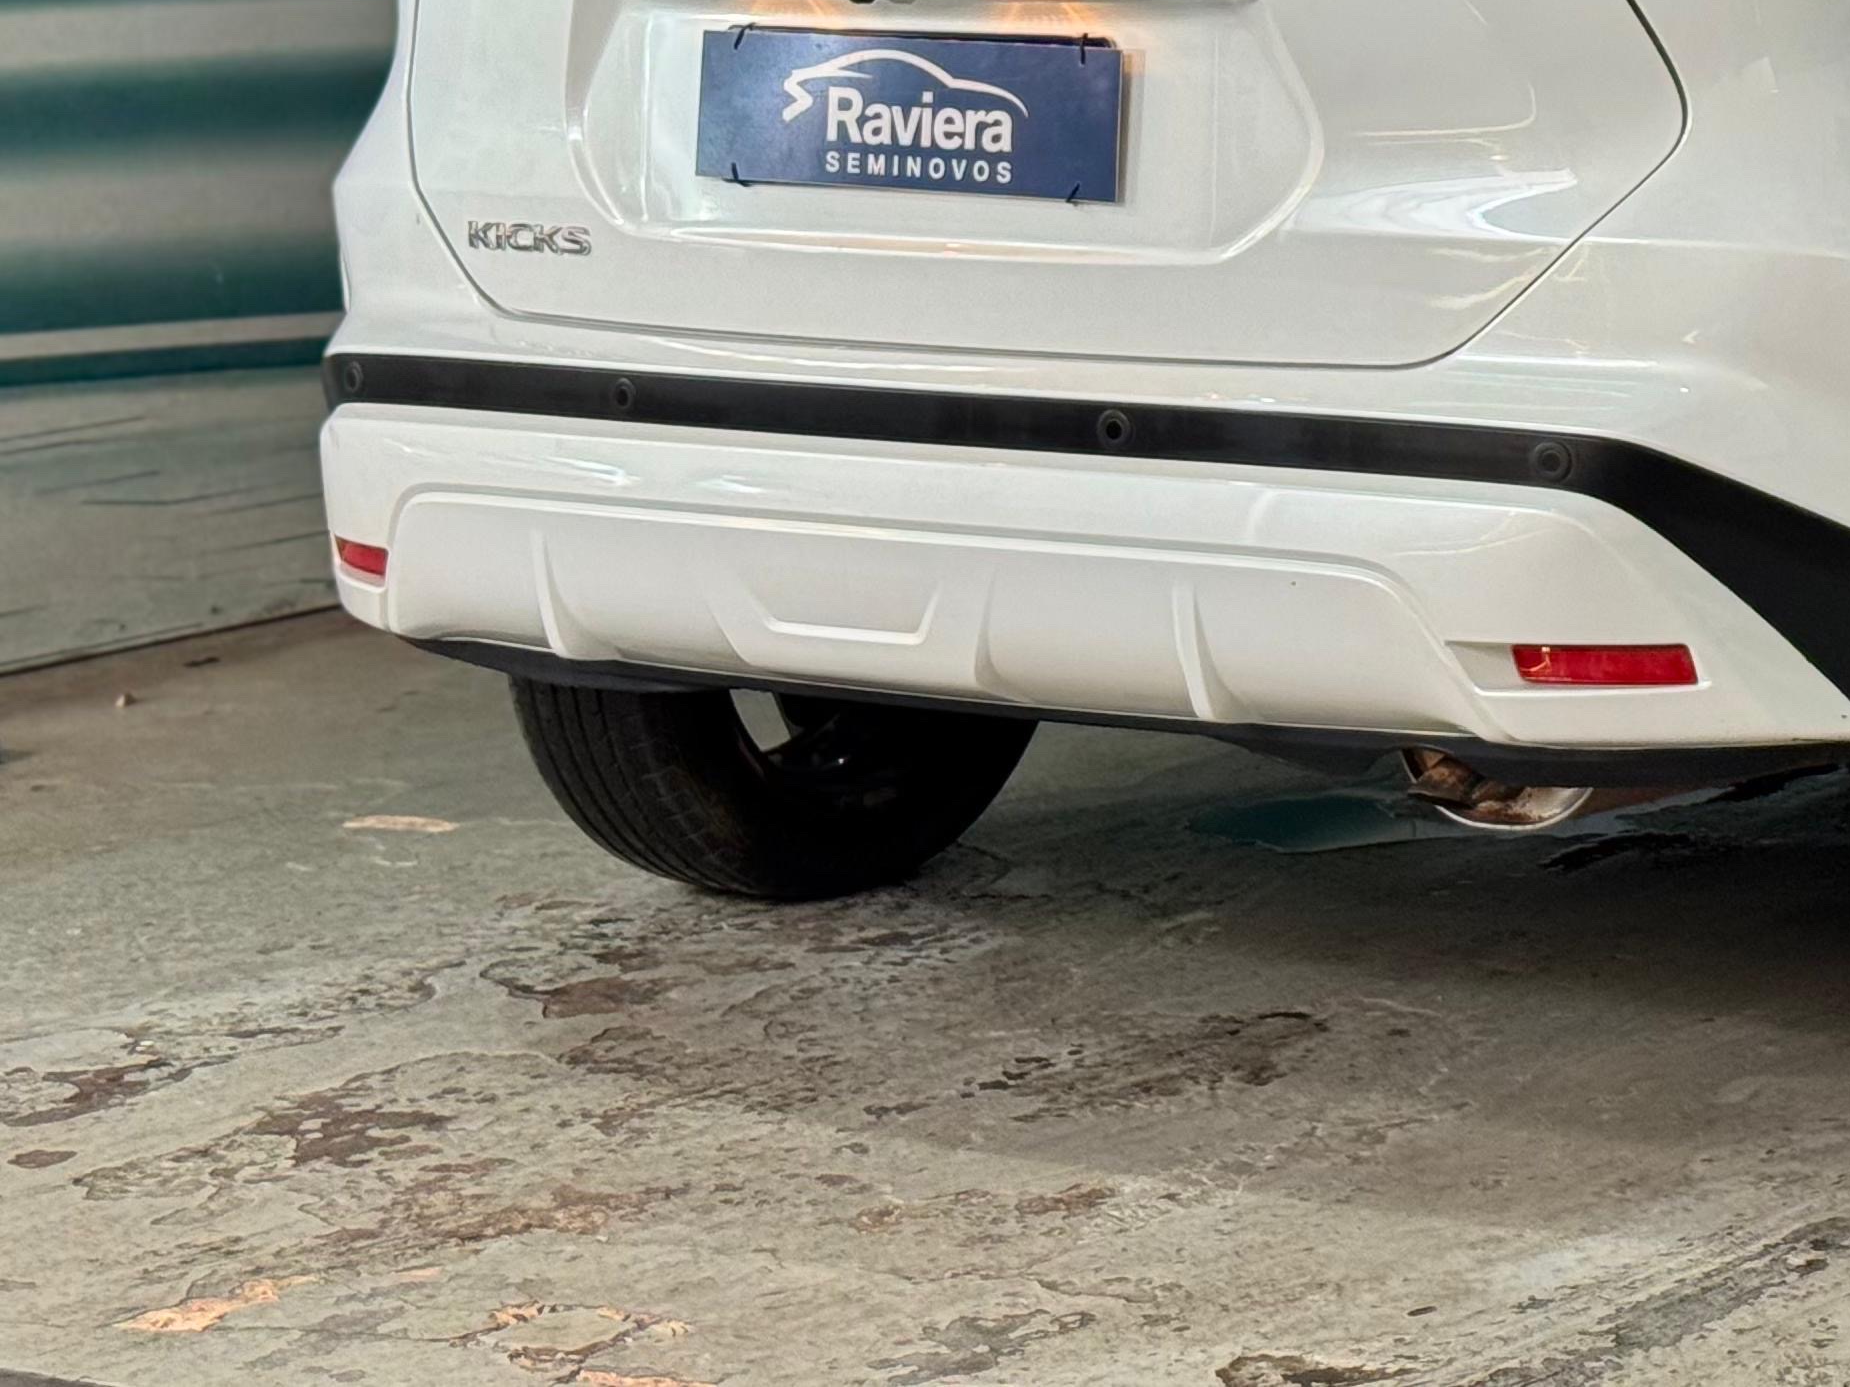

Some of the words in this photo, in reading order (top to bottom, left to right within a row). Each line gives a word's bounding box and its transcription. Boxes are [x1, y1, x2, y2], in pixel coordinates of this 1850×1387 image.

[826, 85, 1013, 153] Raviera
[825, 149, 1013, 185] SEMINOVOS
[468, 220, 593, 256] KICKS
